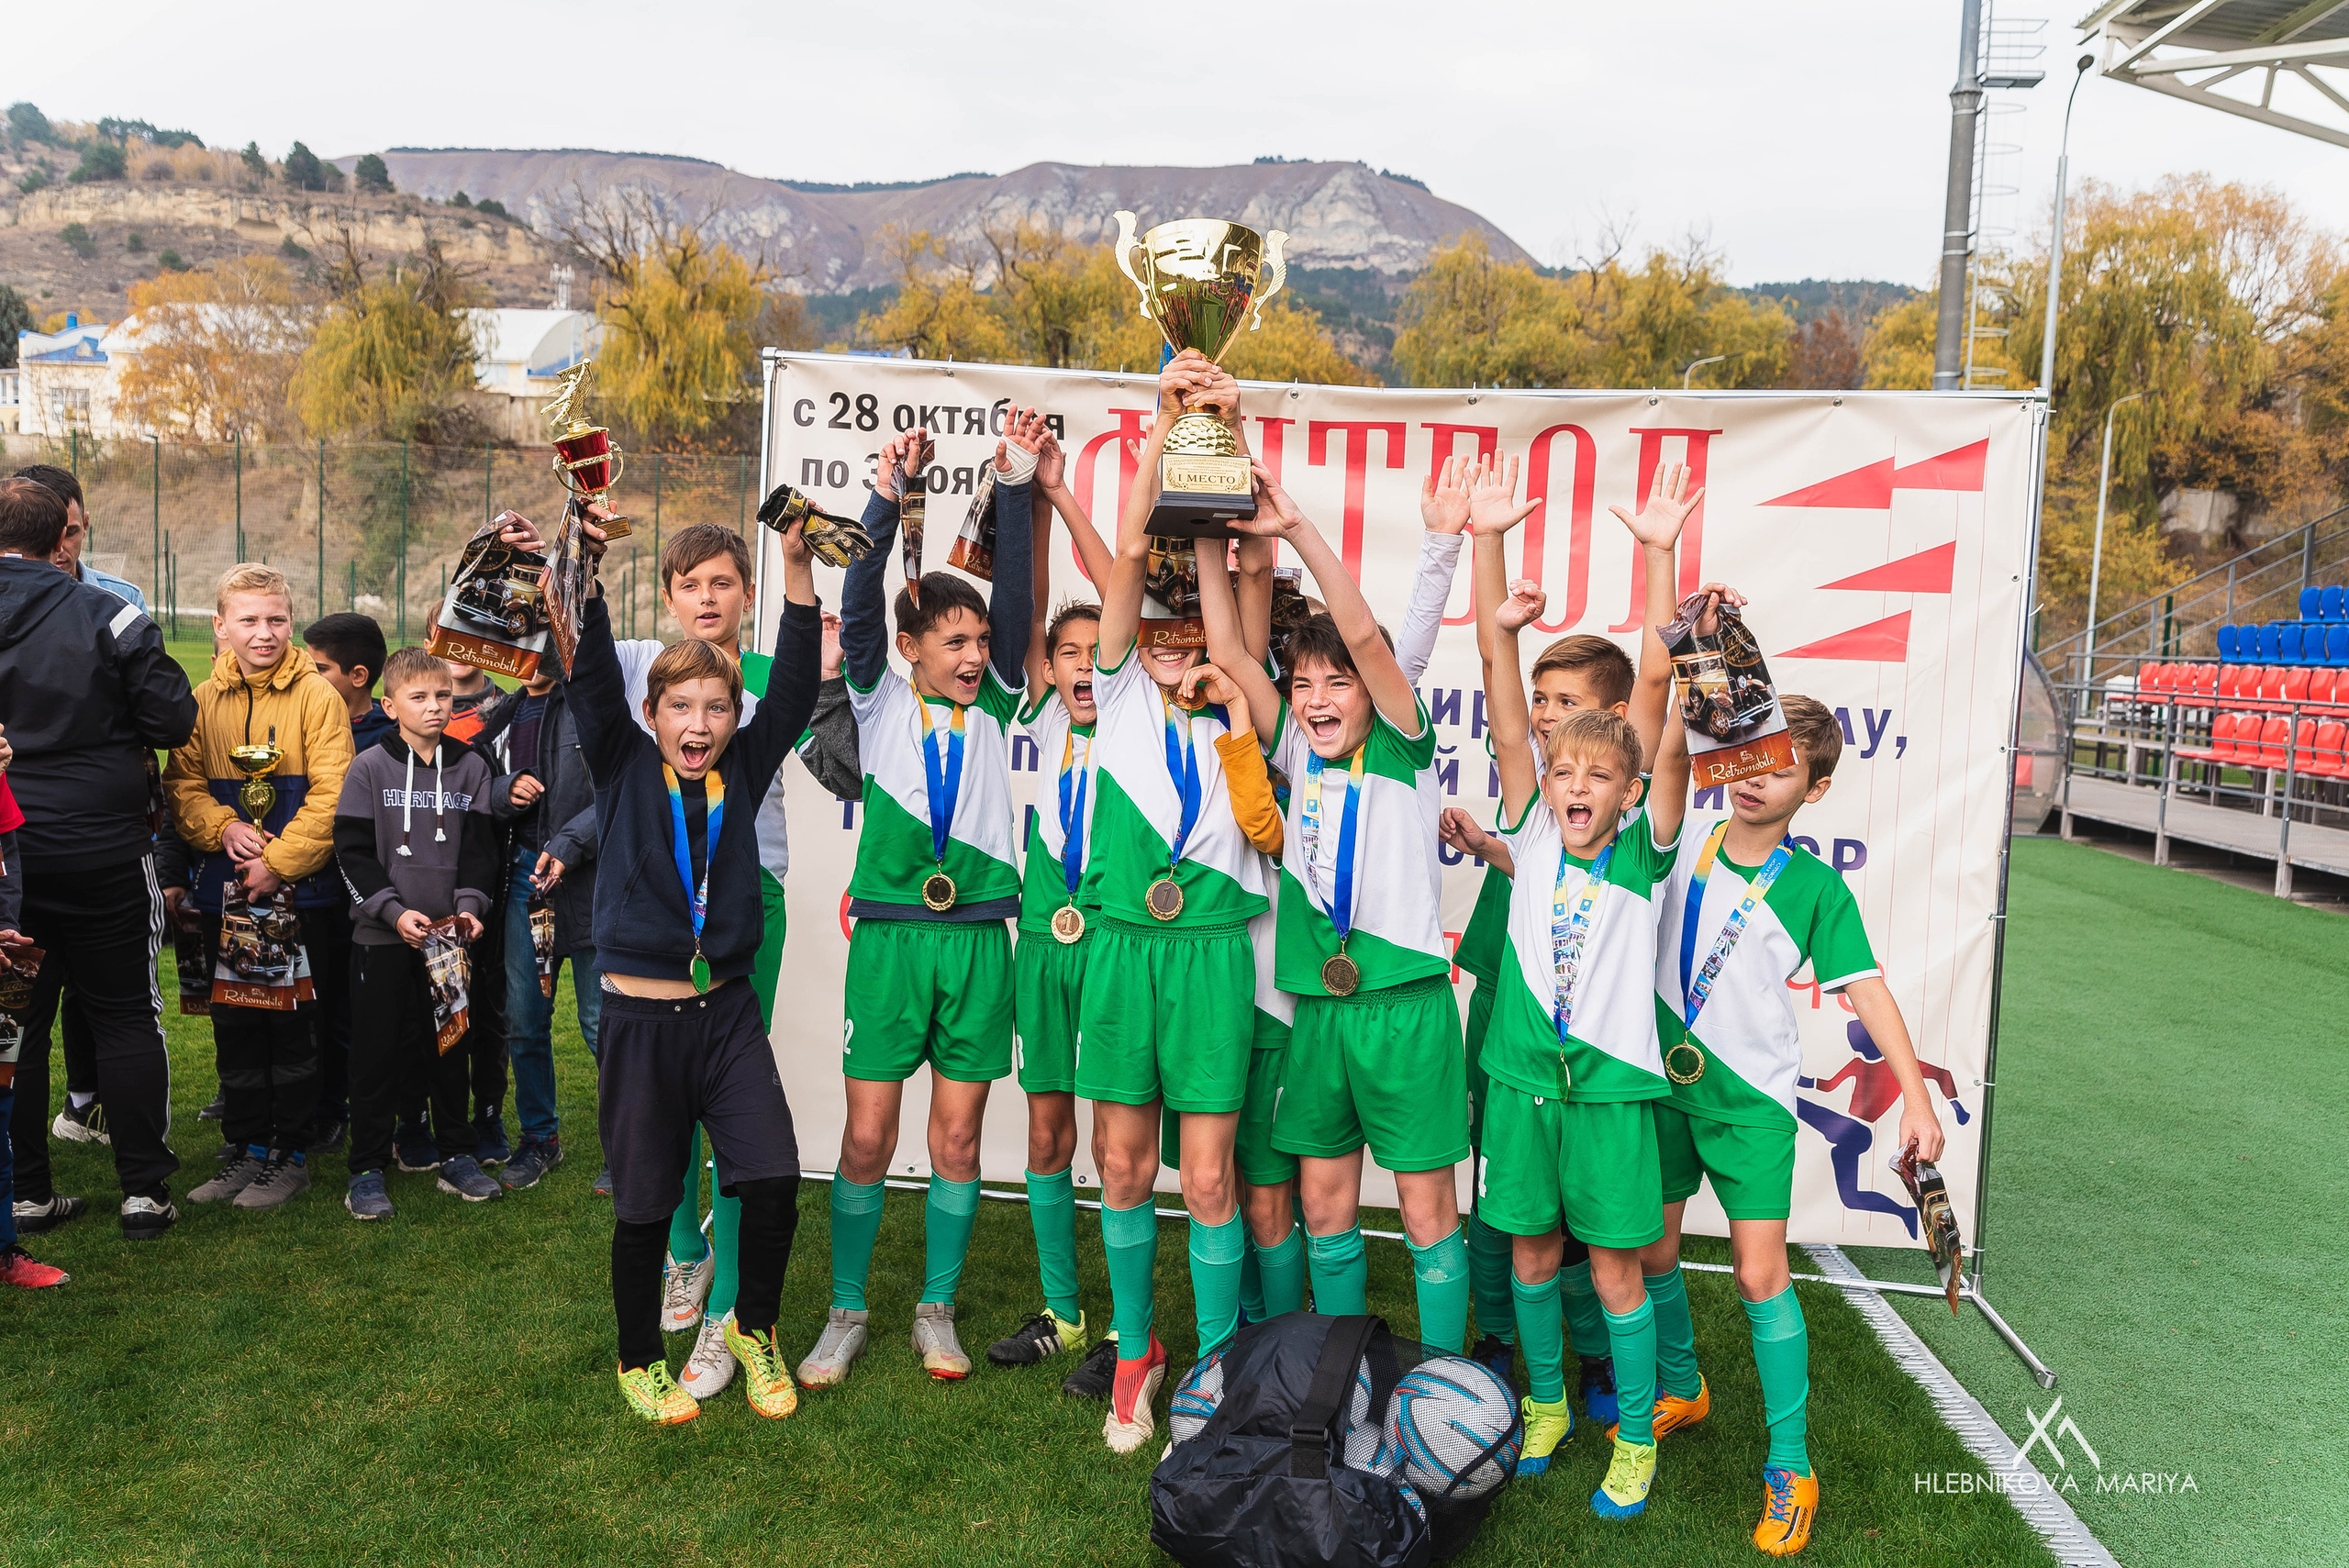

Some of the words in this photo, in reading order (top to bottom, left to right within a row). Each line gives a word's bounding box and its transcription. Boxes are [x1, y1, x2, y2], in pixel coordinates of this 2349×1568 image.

[793, 398, 816, 428] с
[828, 392, 879, 432] 28
[893, 397, 1064, 441] октябя
[801, 458, 850, 488] по
[1186, 473, 1236, 484] МЕСТО
[1152, 629, 1208, 646] Retromob
[446, 640, 520, 674] Retromobile
[1707, 752, 1777, 783] Retromobile
[1063, 912, 1073, 934] 1
[223, 988, 284, 1007] Retromobile
